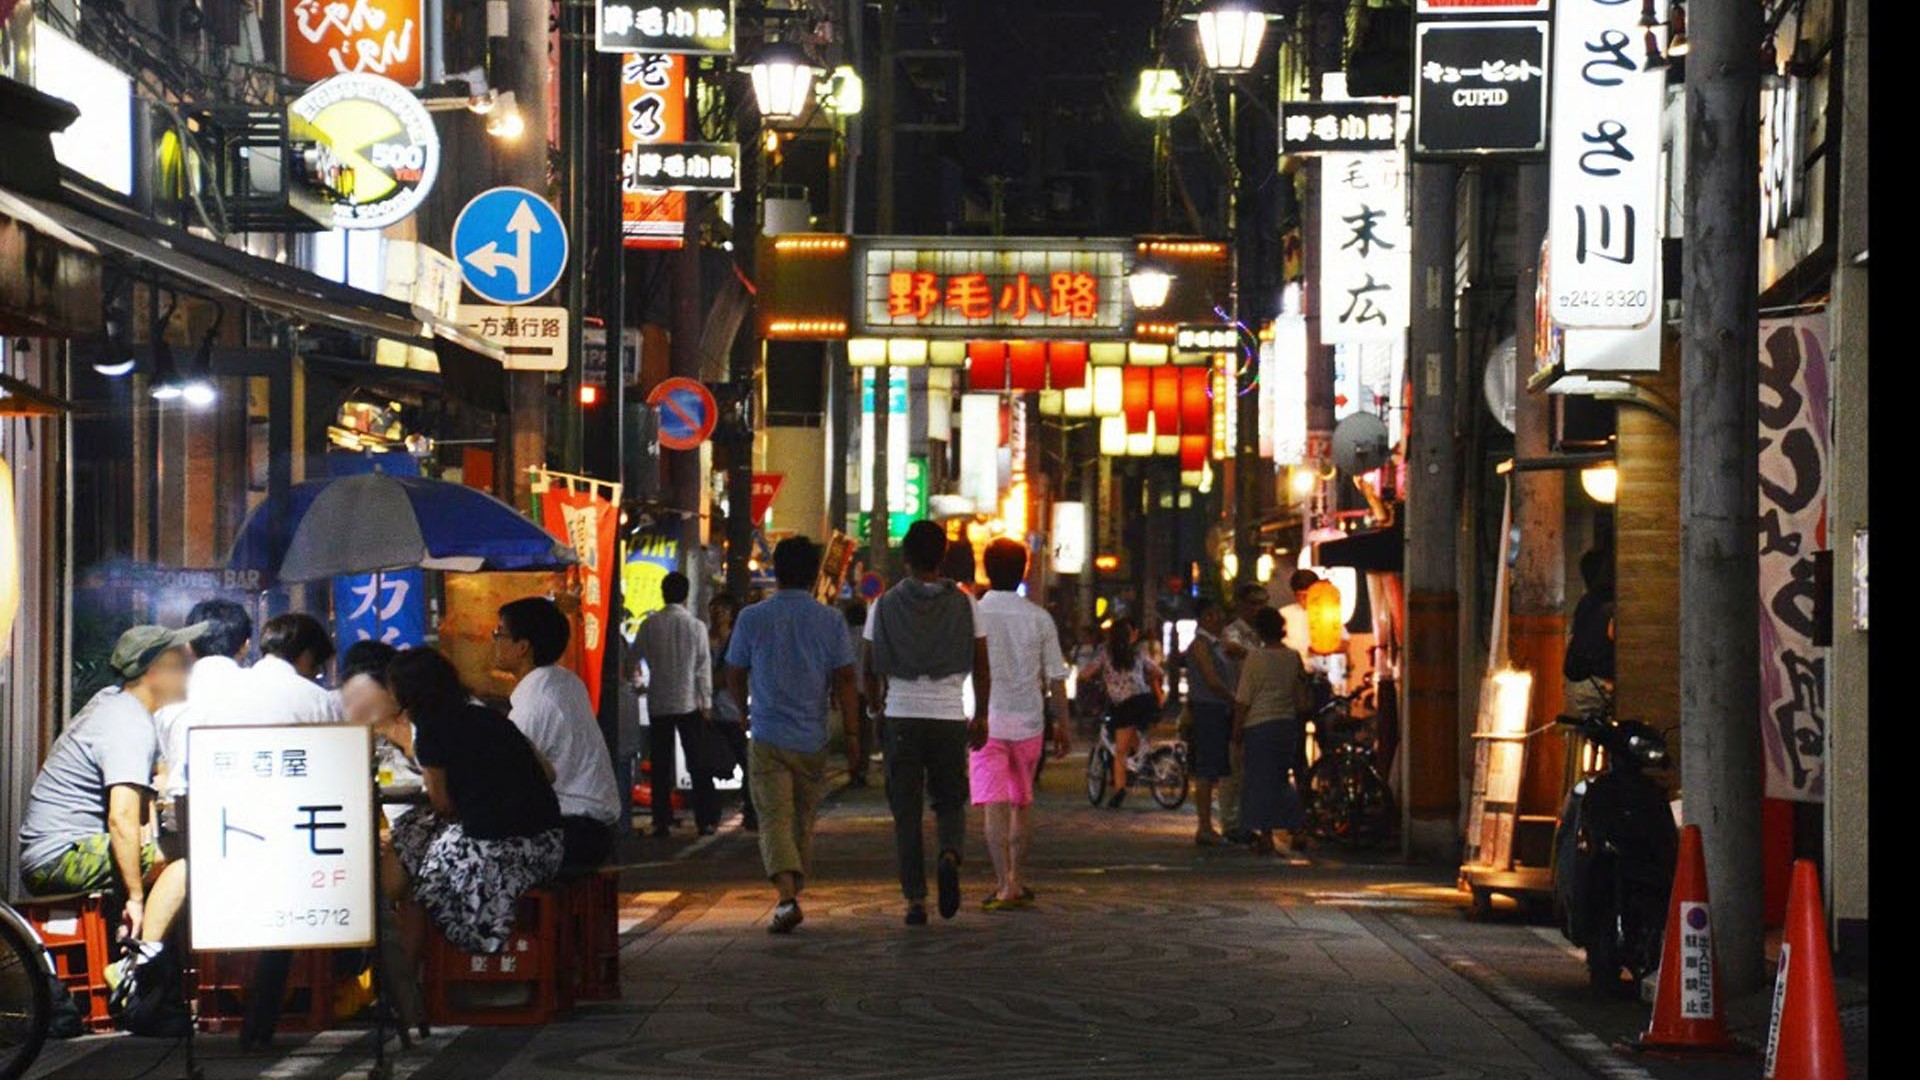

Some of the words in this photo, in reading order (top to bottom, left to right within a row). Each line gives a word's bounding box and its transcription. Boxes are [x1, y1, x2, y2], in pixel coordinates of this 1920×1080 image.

[1453, 88, 1509, 106] CUPID
[373, 144, 424, 169] 500
[1339, 203, 1395, 327] 末広
[888, 271, 1099, 319] 野毛小路
[220, 804, 347, 859] トモ
[312, 869, 346, 888] 2F
